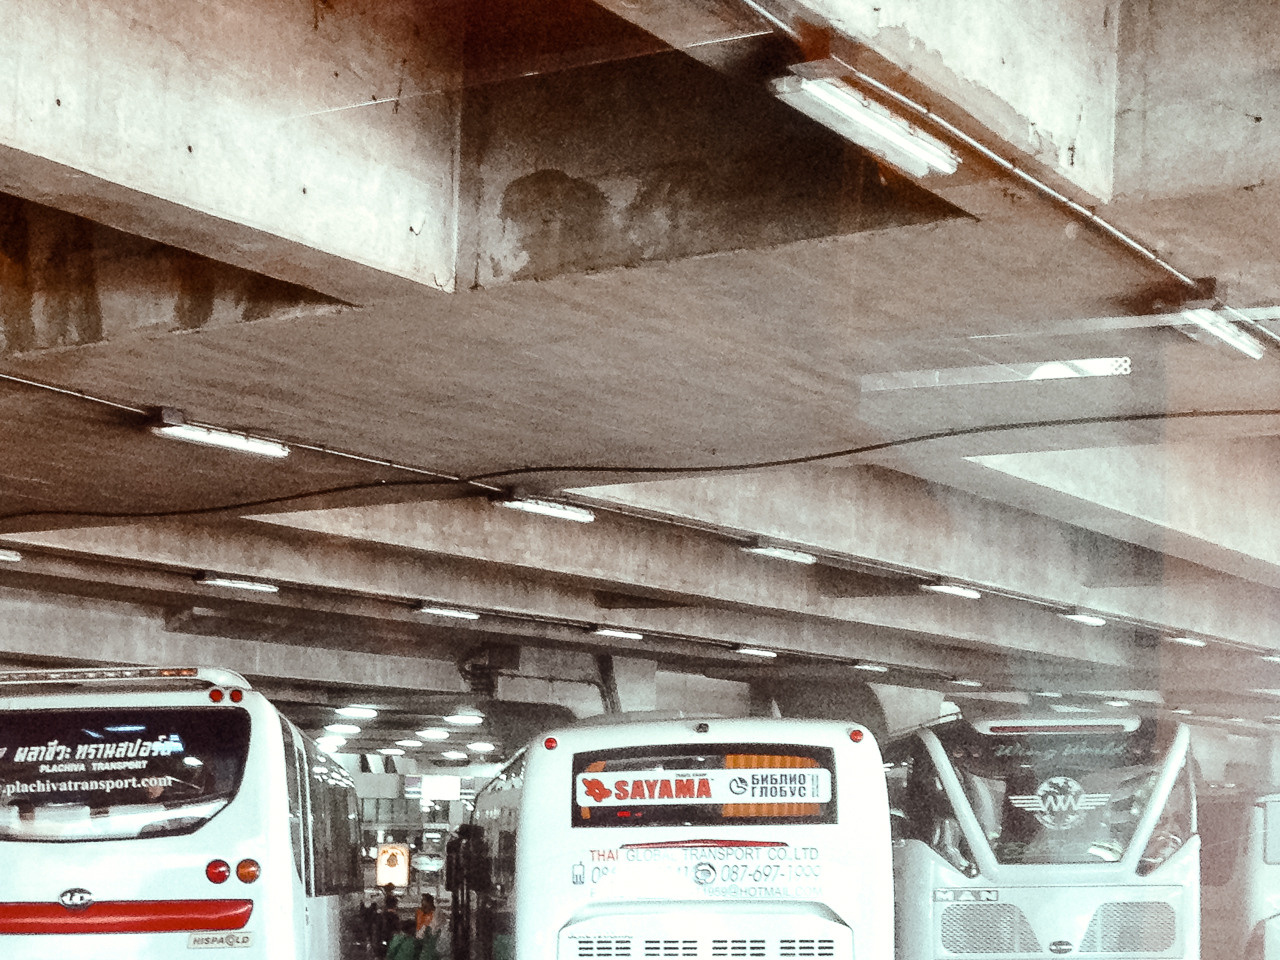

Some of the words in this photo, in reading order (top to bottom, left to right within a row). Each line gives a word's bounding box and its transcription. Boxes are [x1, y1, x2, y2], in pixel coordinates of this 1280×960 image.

[39, 763, 86, 773] PLACHIVA
[92, 760, 148, 771] TRANSPORT
[751, 773, 806, 785] БИБЛИО
[614, 779, 712, 800] SAYAMA
[751, 786, 807, 798] ГЛОБУС
[590, 849, 619, 861] THAI
[682, 848, 762, 860] TRANSPORT
[935, 889, 997, 901] MAN
